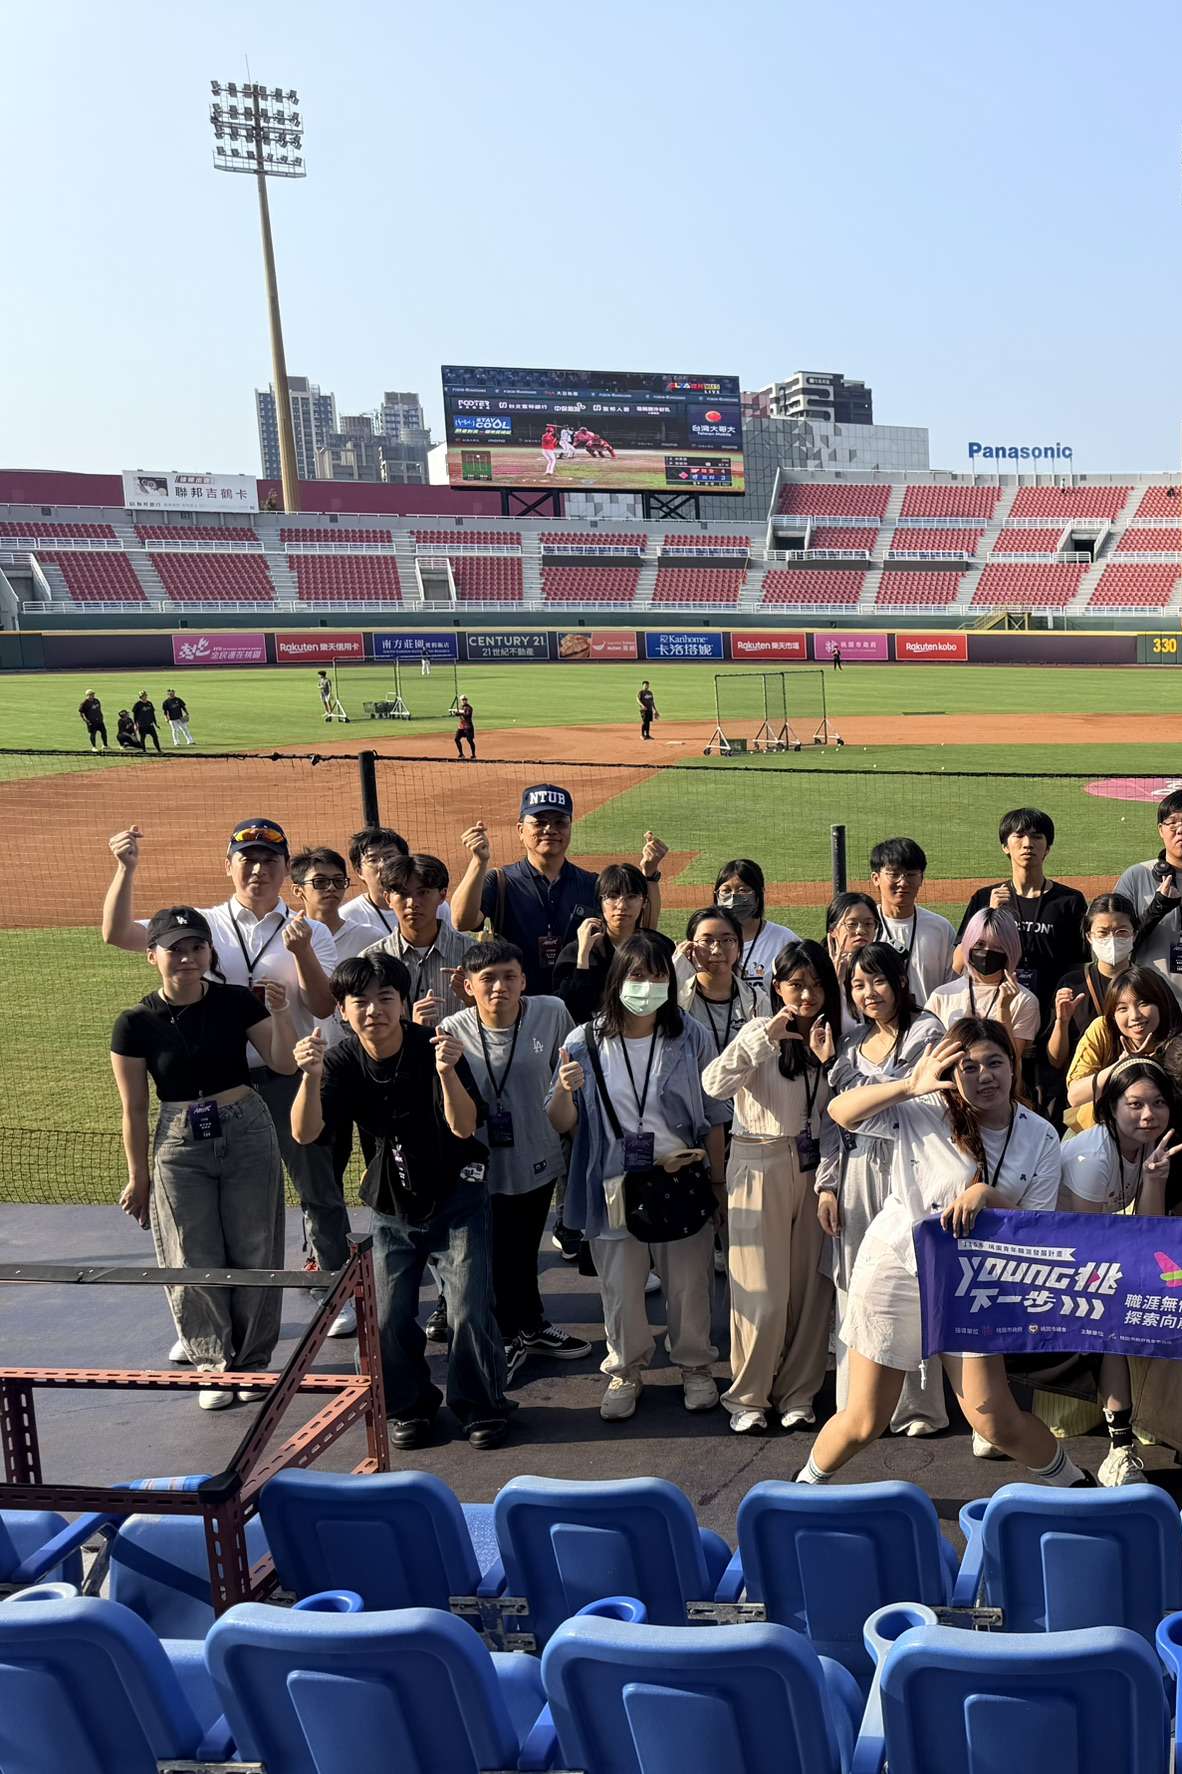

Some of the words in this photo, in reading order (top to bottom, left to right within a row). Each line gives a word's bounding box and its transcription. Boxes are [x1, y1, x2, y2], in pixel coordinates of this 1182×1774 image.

[968, 441, 1073, 459] Panasonic
[175, 486, 248, 500] 聯邦吉鶴卡
[468, 636, 529, 646] CENTURY
[532, 636, 545, 646] 21
[738, 641, 771, 652] Rakuten
[906, 642, 937, 653] Rakuten
[938, 642, 957, 651] kobo
[1153, 638, 1177, 653] 330
[280, 643, 319, 654] Rakuten
[482, 647, 535, 657] 21世紀不動產
[529, 790, 566, 805] NTUB
[532, 1037, 545, 1053] LA
[970, 1289, 1057, 1313] 下一步
